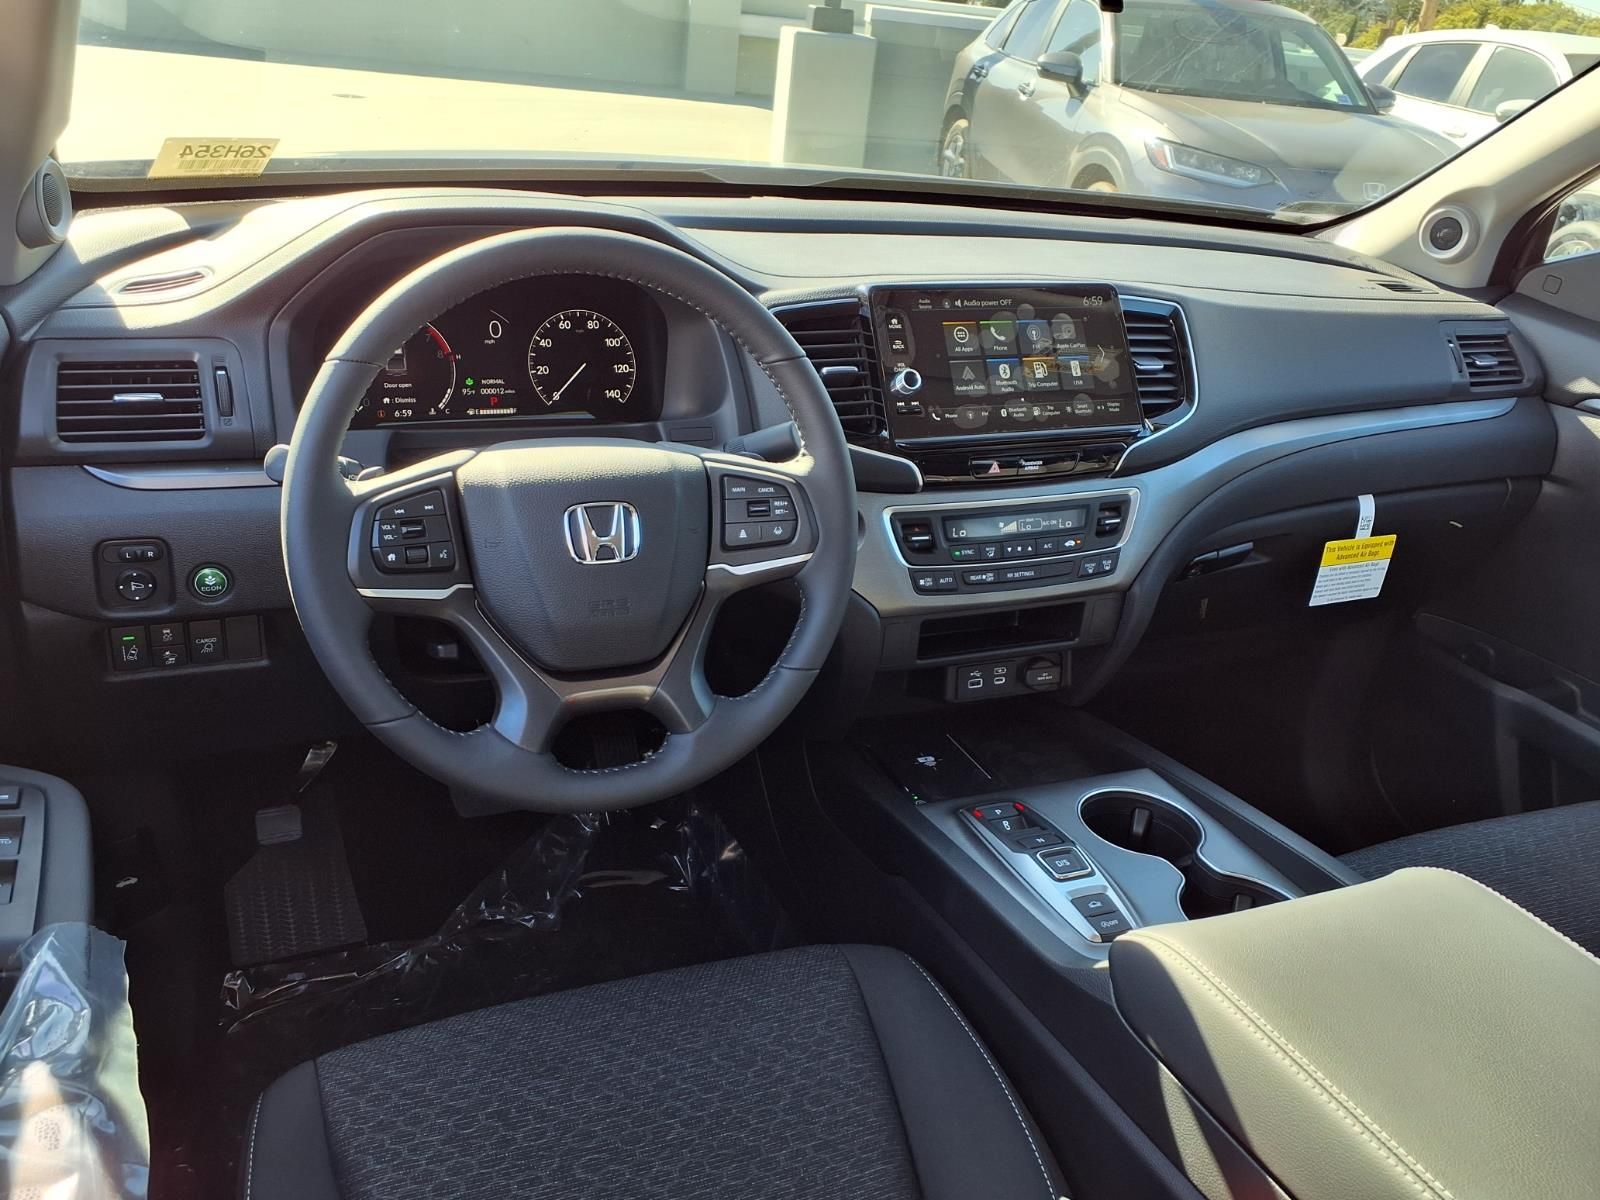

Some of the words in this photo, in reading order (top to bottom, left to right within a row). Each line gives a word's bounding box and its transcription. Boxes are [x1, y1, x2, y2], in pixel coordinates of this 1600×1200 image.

[1083, 296, 1103, 306] 6:59
[489, 320, 502, 338] 0
[559, 320, 571, 329] 60
[587, 320, 599, 329] 80
[540, 338, 552, 347] 40
[605, 338, 621, 347] 100
[536, 365, 549, 374] 20
[613, 364, 629, 373] 120
[604, 389, 621, 398] 140
[394, 409, 413, 417] 6:59
[1058, 518, 1072, 528] Lo
[952, 528, 967, 537] Lo
[1337, 544, 1354, 552] Vehicle
[1361, 541, 1383, 550] Equipped
[1336, 552, 1359, 560] Advanced
[1002, 820, 1011, 831] R
[1055, 859, 1070, 867] D/S
